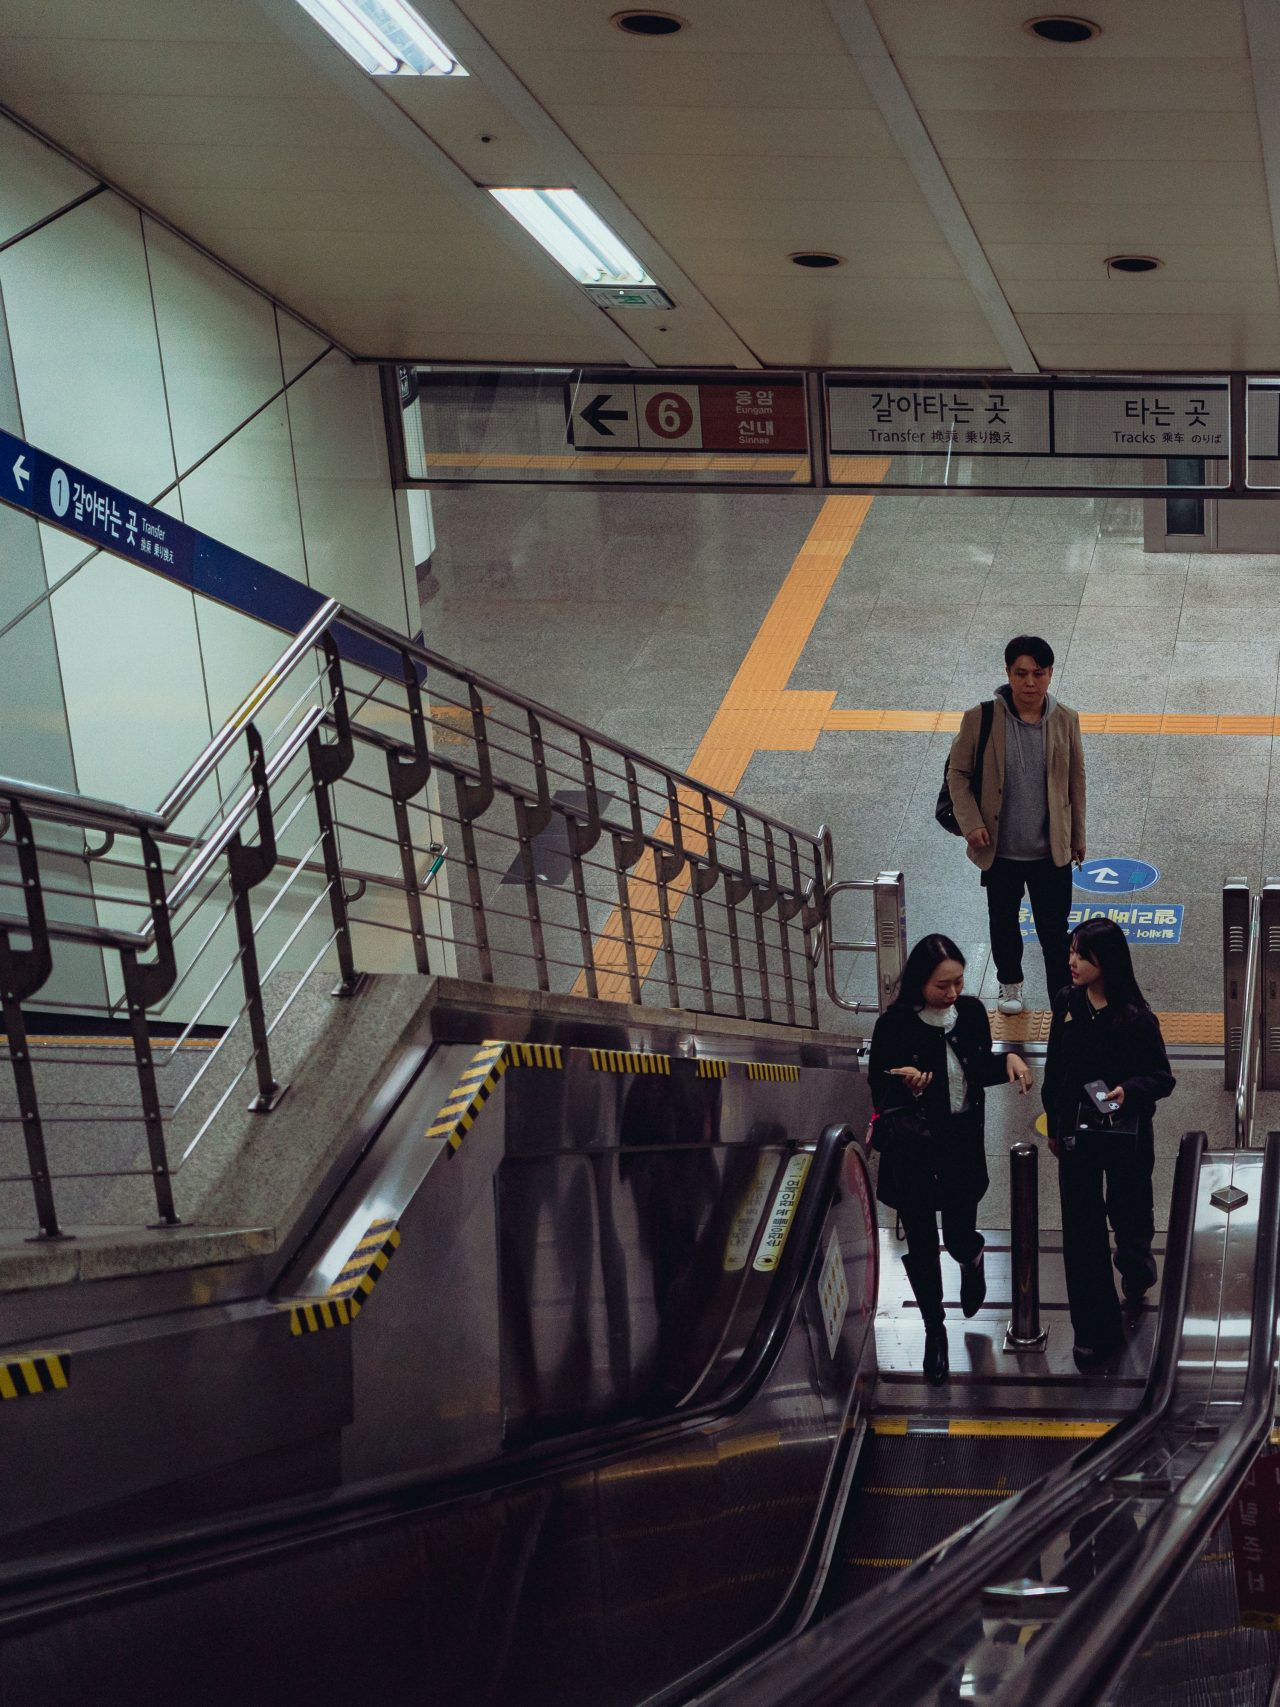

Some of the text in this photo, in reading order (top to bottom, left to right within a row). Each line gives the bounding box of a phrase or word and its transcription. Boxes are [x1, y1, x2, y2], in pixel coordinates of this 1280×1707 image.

[736, 390, 774, 405] 응암
[658, 399, 681, 432] 6
[736, 405, 773, 415] Eungam
[871, 392, 1010, 424] 갈아타는 곳
[1125, 398, 1210, 427] 타는 곳
[738, 420, 774, 436] 신내
[868, 429, 925, 442] Transfer
[738, 436, 770, 444] Sinnae
[1112, 431, 1157, 444] Tracks
[1191, 434, 1222, 444] のりば
[73, 482, 122, 539] 갈아타는
[125, 509, 138, 547] 곳
[142, 517, 166, 541] Transfer
